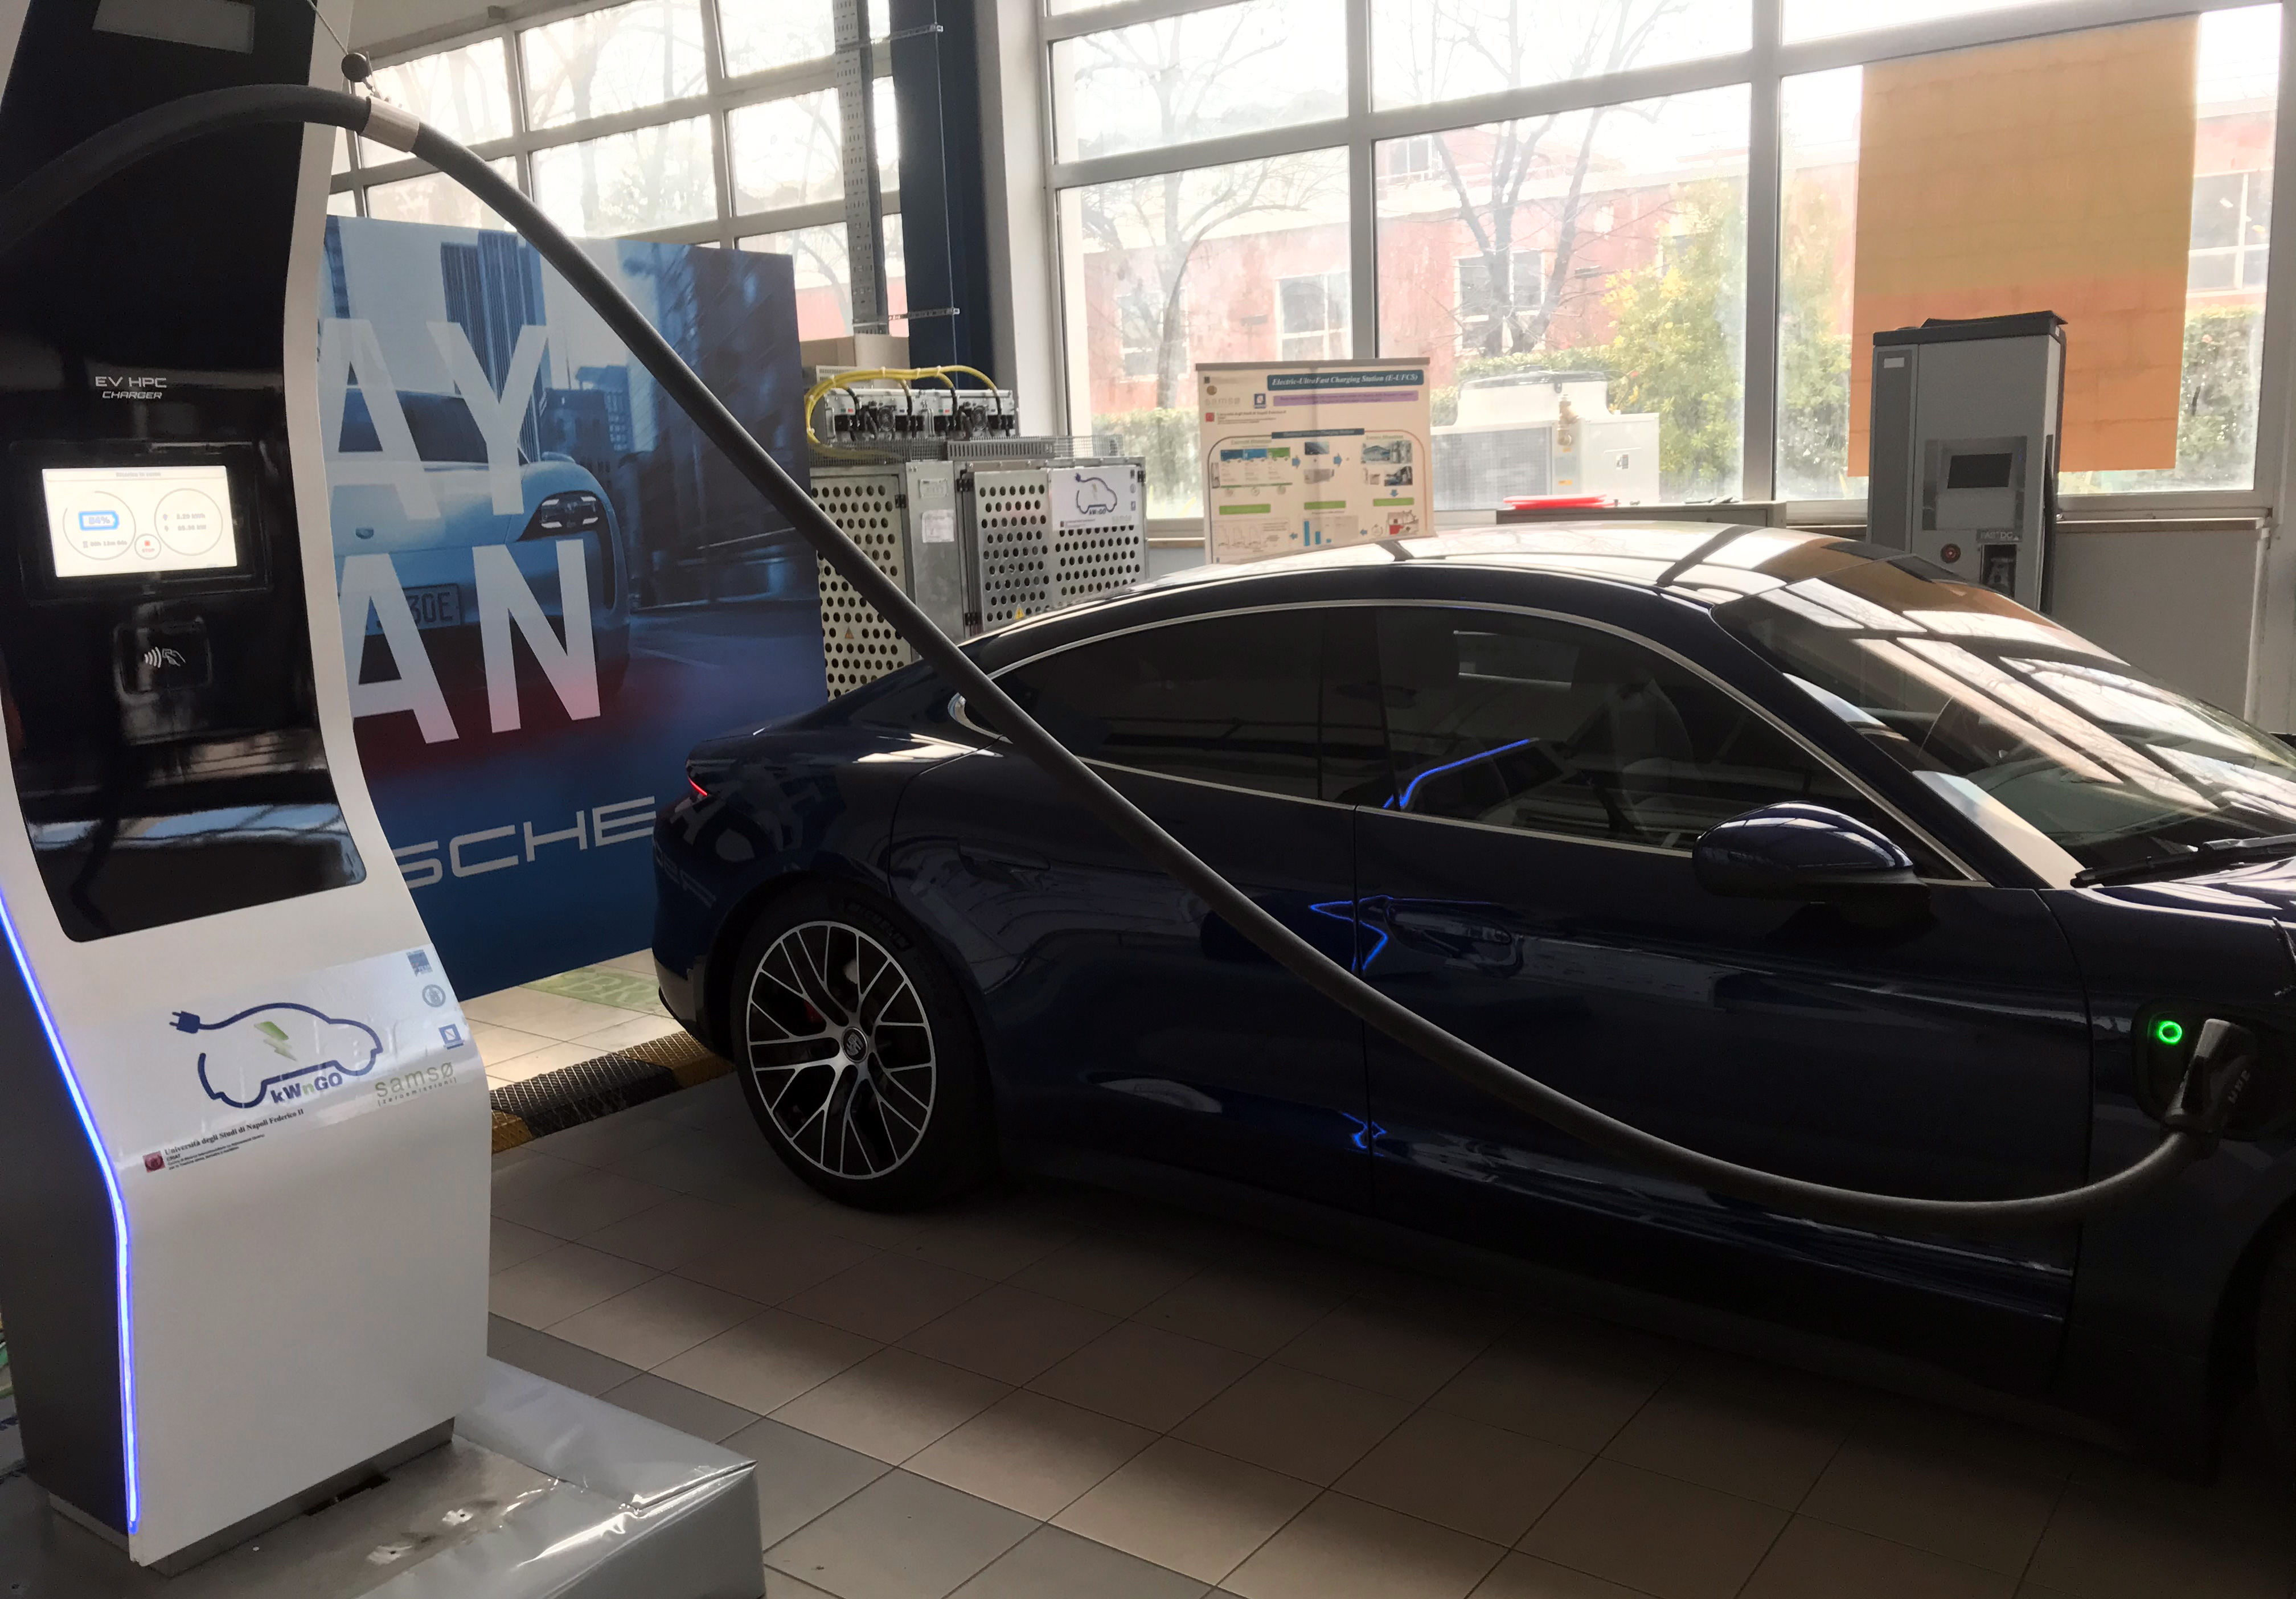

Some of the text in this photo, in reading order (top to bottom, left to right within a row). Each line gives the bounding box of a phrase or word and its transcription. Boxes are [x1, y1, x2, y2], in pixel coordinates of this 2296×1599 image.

[95, 376, 167, 388] EV HPC
[102, 391, 162, 399] CHARGER
[270, 1072, 343, 1104] kWnGO
[375, 1061, 454, 1098] samsø
[165, 1139, 201, 1155] Università
[202, 1134, 219, 1145] degli
[219, 1129, 238, 1139] Studi
[239, 1125, 246, 1134] di
[246, 1118, 269, 1131] Napoli
[269, 1112, 297, 1124] Federico
